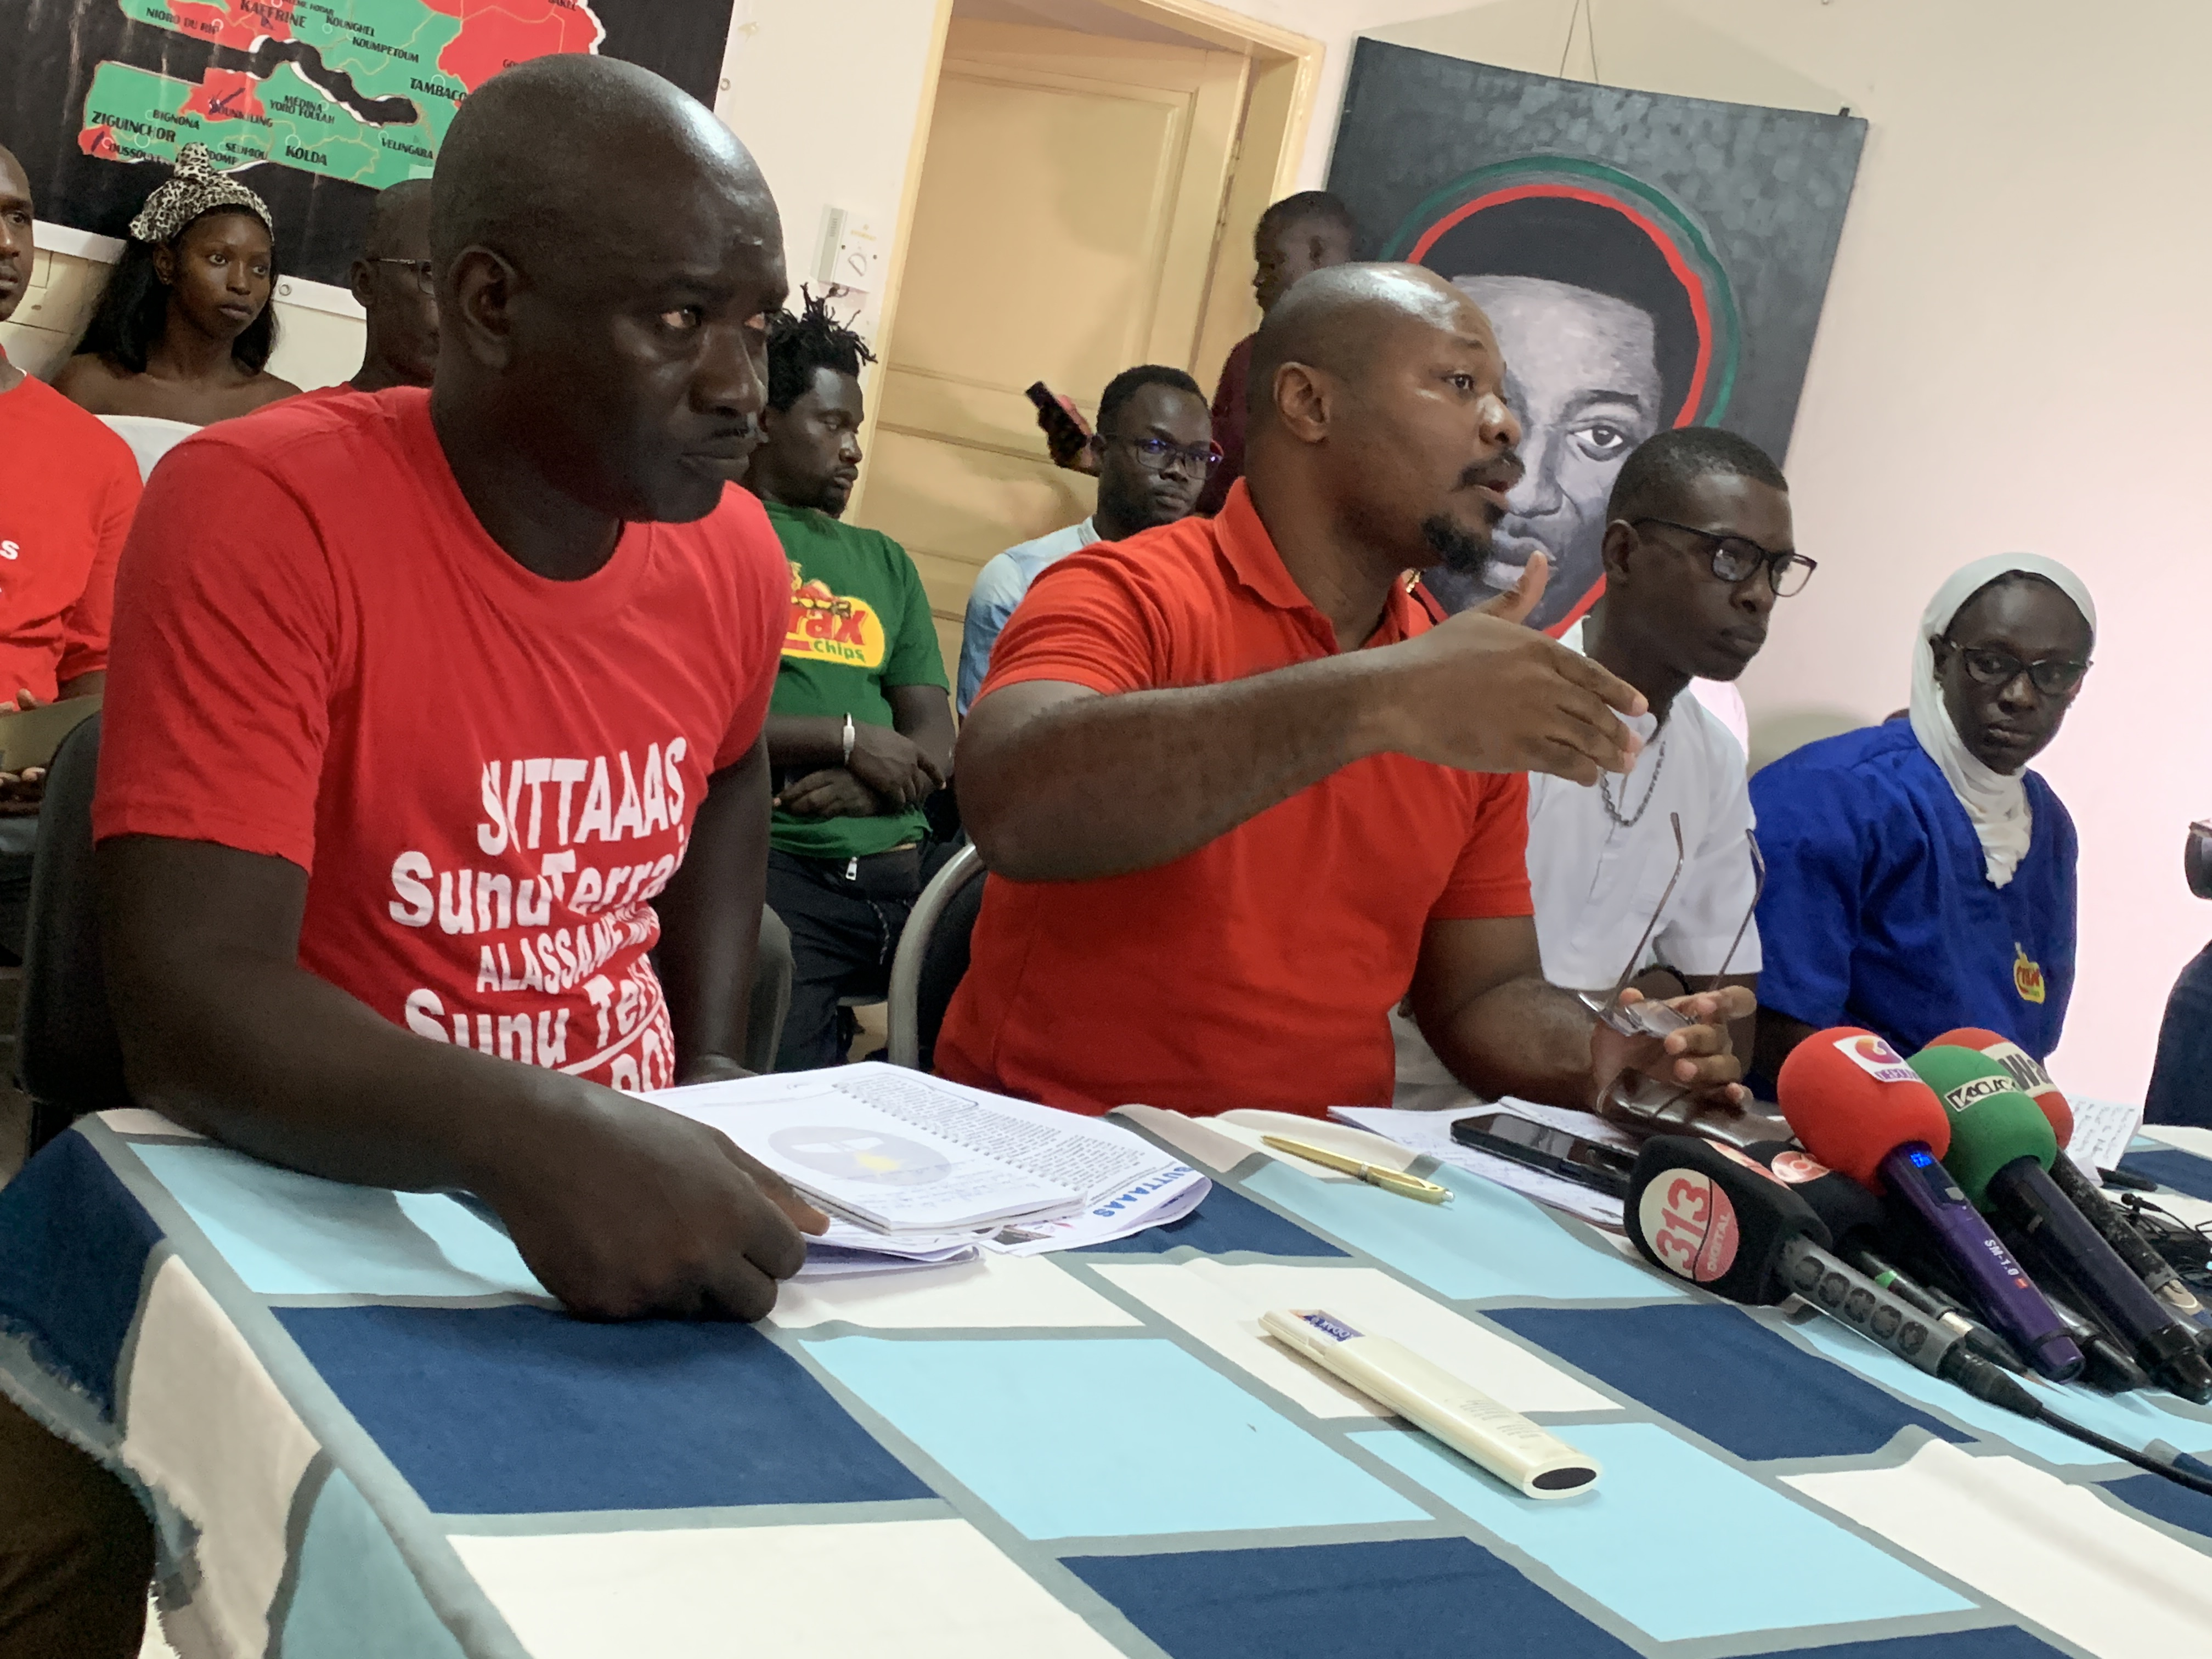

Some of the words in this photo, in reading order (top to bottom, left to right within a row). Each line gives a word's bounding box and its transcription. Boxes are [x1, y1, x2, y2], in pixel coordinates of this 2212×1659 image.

[146, 7, 180, 24] NIORO
[184, 17, 198, 30] DU
[240, 0, 307, 28] KAFFRINE
[352, 36, 419, 63] KOUMPETOUM
[92, 111, 176, 143] ZIGUINCHOR
[153, 109, 200, 129] BIGNONA
[285, 145, 328, 166] KOLDA
[381, 138, 433, 160] VELINGARA
[814, 640, 866, 663] Chips
[388, 851, 552, 935] Sunu
[404, 988, 570, 1068] Sunu
[1656, 1177, 1711, 1271] 313
[1707, 1212, 1732, 1273] DIGITAL
[1984, 1239, 2019, 1276] SM-1.0
